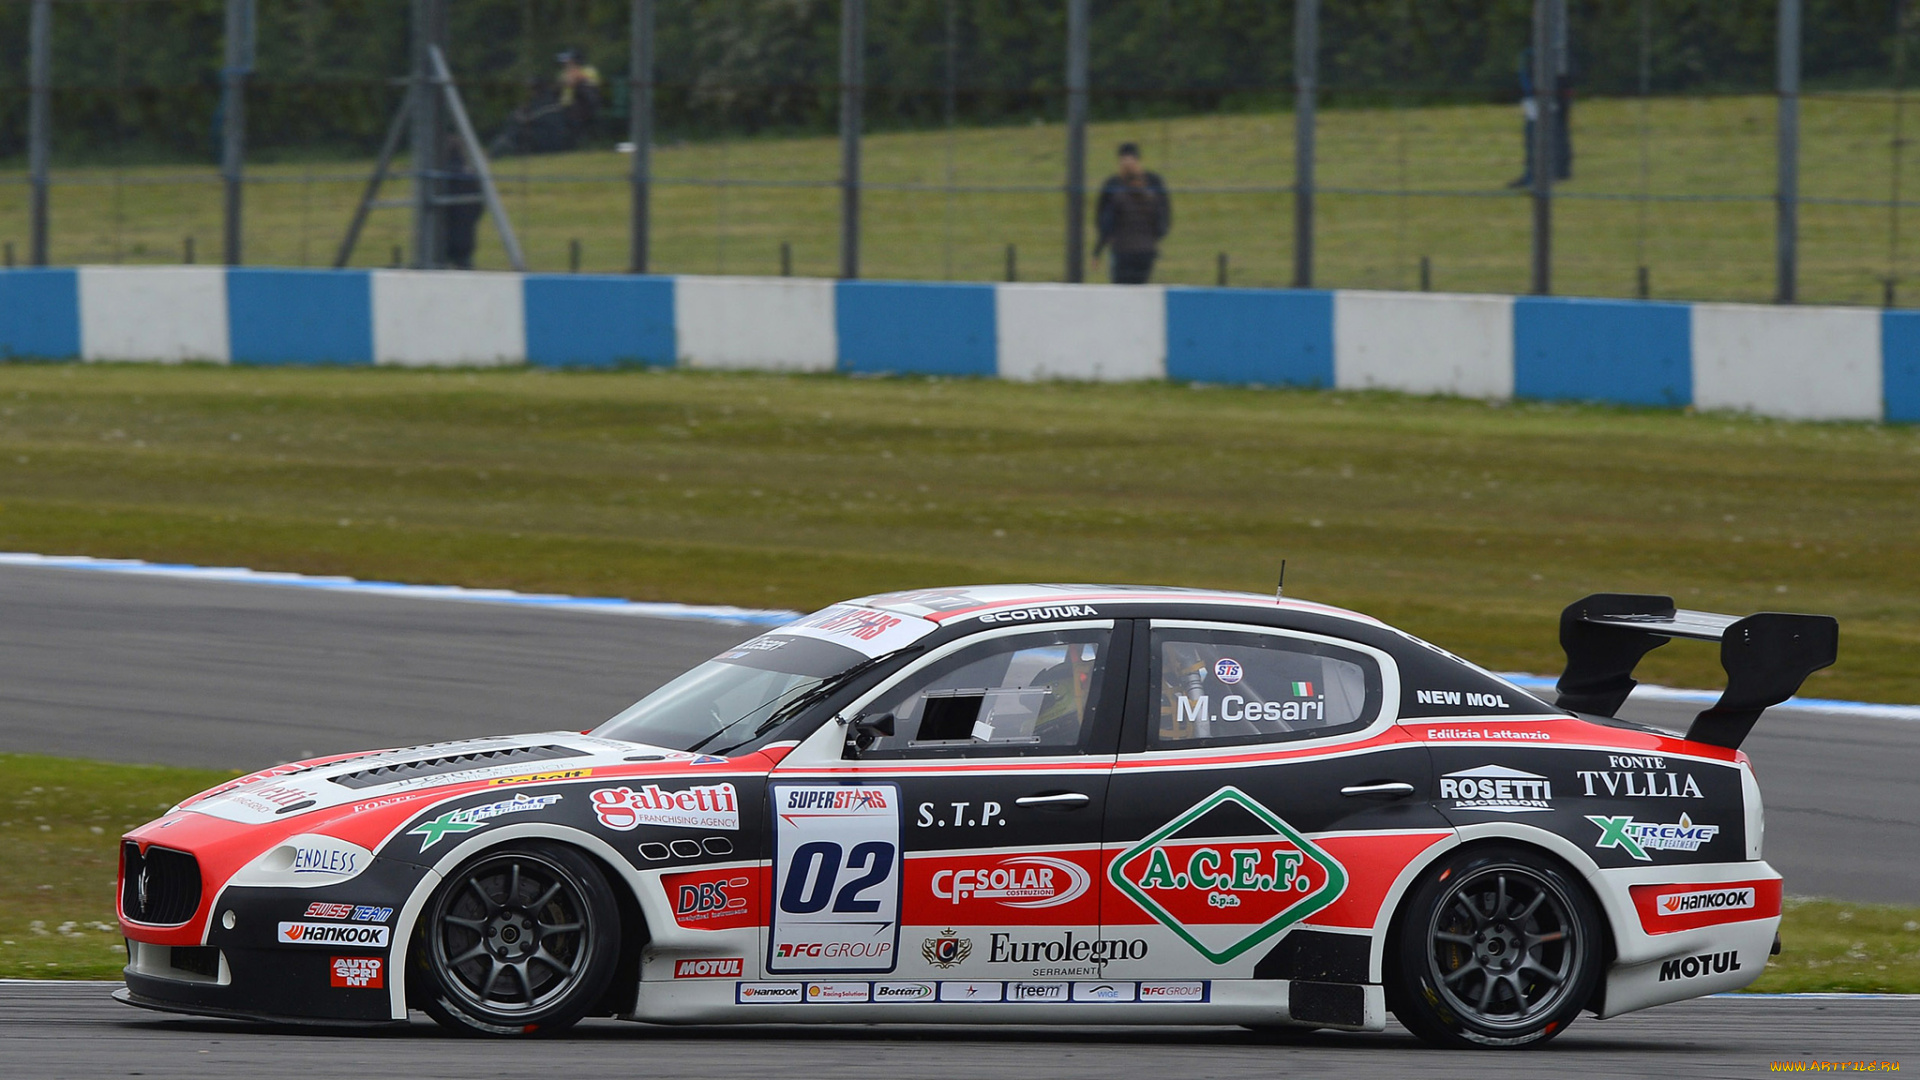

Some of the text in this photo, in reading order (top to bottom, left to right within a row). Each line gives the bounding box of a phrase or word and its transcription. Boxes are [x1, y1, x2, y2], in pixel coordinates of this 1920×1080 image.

[1217, 665, 1240, 676] STS
[1416, 690, 1510, 708] NEW MOL
[1427, 729, 1550, 740] Edilizia Lattanzio
[1608, 755, 1666, 769] FONTE
[1440, 779, 1552, 799] ROSETTI
[1576, 770, 1704, 798] TVLLIA
[593, 786, 736, 827] gabetti
[788, 789, 887, 812] SUPERSTARS
[1455, 799, 1549, 808] ASCENSORI
[639, 814, 737, 828] FRANCHISING AGENCY
[917, 802, 1006, 827] S.T.P.
[1584, 816, 1711, 860] XTREME
[1639, 837, 1699, 850] FUEL TREATMENT
[294, 848, 356, 872] ENDLESS
[1139, 847, 1310, 891] A.C.E.F.
[779, 841, 895, 914] 02
[677, 880, 728, 915] DBS
[304, 902, 393, 921] SWISS TEAM
[824, 943, 891, 957] GROUP
[987, 931, 1148, 968] Eurolegno
[333, 958, 381, 969] AUTO
[678, 961, 740, 975] MOTUL
[1658, 950, 1741, 982] MOTUL
[336, 968, 377, 979] SPRI
[346, 977, 370, 986] NT
[878, 986, 922, 996] Bottari
[1166, 986, 1202, 996] GROUP
